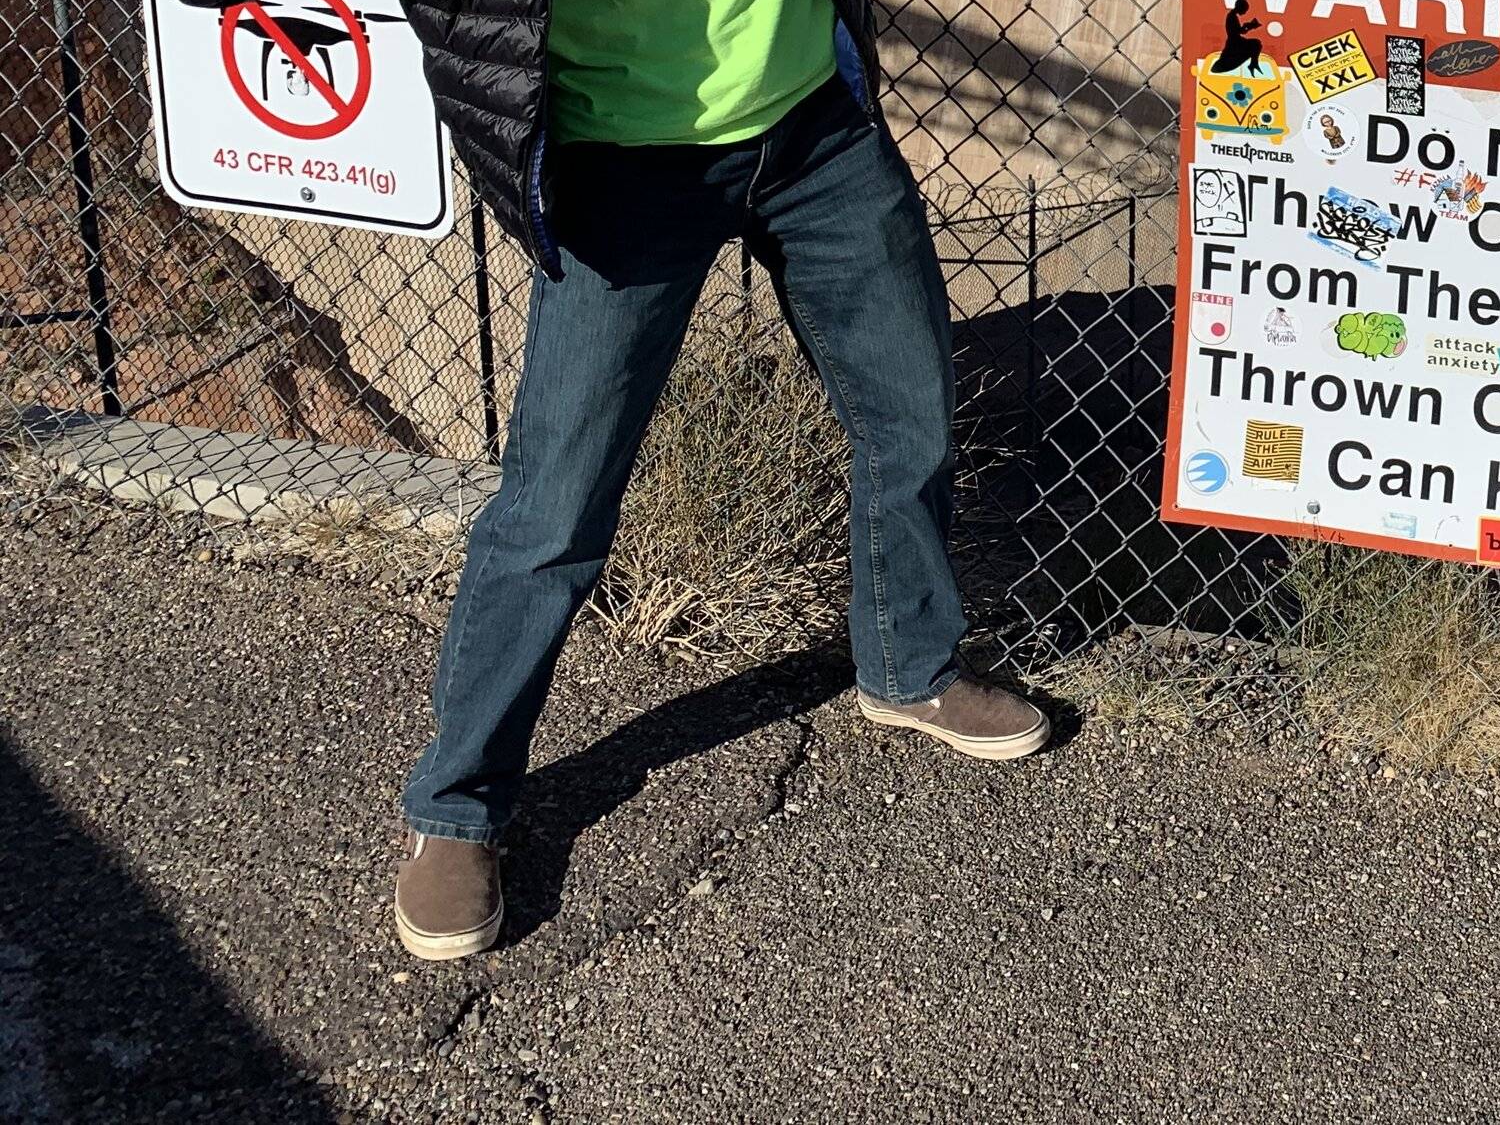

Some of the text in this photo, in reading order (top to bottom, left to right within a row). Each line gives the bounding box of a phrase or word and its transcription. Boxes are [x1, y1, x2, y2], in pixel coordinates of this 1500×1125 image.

[1297, 34, 1357, 68] CZEK
[1315, 66, 1368, 94] XXL
[1367, 115, 1454, 171] Do
[213, 148, 396, 195] 43 CFR 423.41(g)
[1248, 174, 1439, 244] Thw
[1440, 210, 1469, 222] TEAM
[1201, 242, 1358, 308] From
[1386, 264, 1500, 326] The
[1192, 293, 1233, 306] SKINE
[1434, 337, 1497, 355] attack
[1427, 355, 1500, 375] anxiety
[1199, 347, 1442, 426] Thrown
[1254, 443, 1279, 454] THE
[1255, 429, 1288, 441] RULE
[1252, 458, 1274, 468] AIR
[1328, 440, 1455, 504] Can
